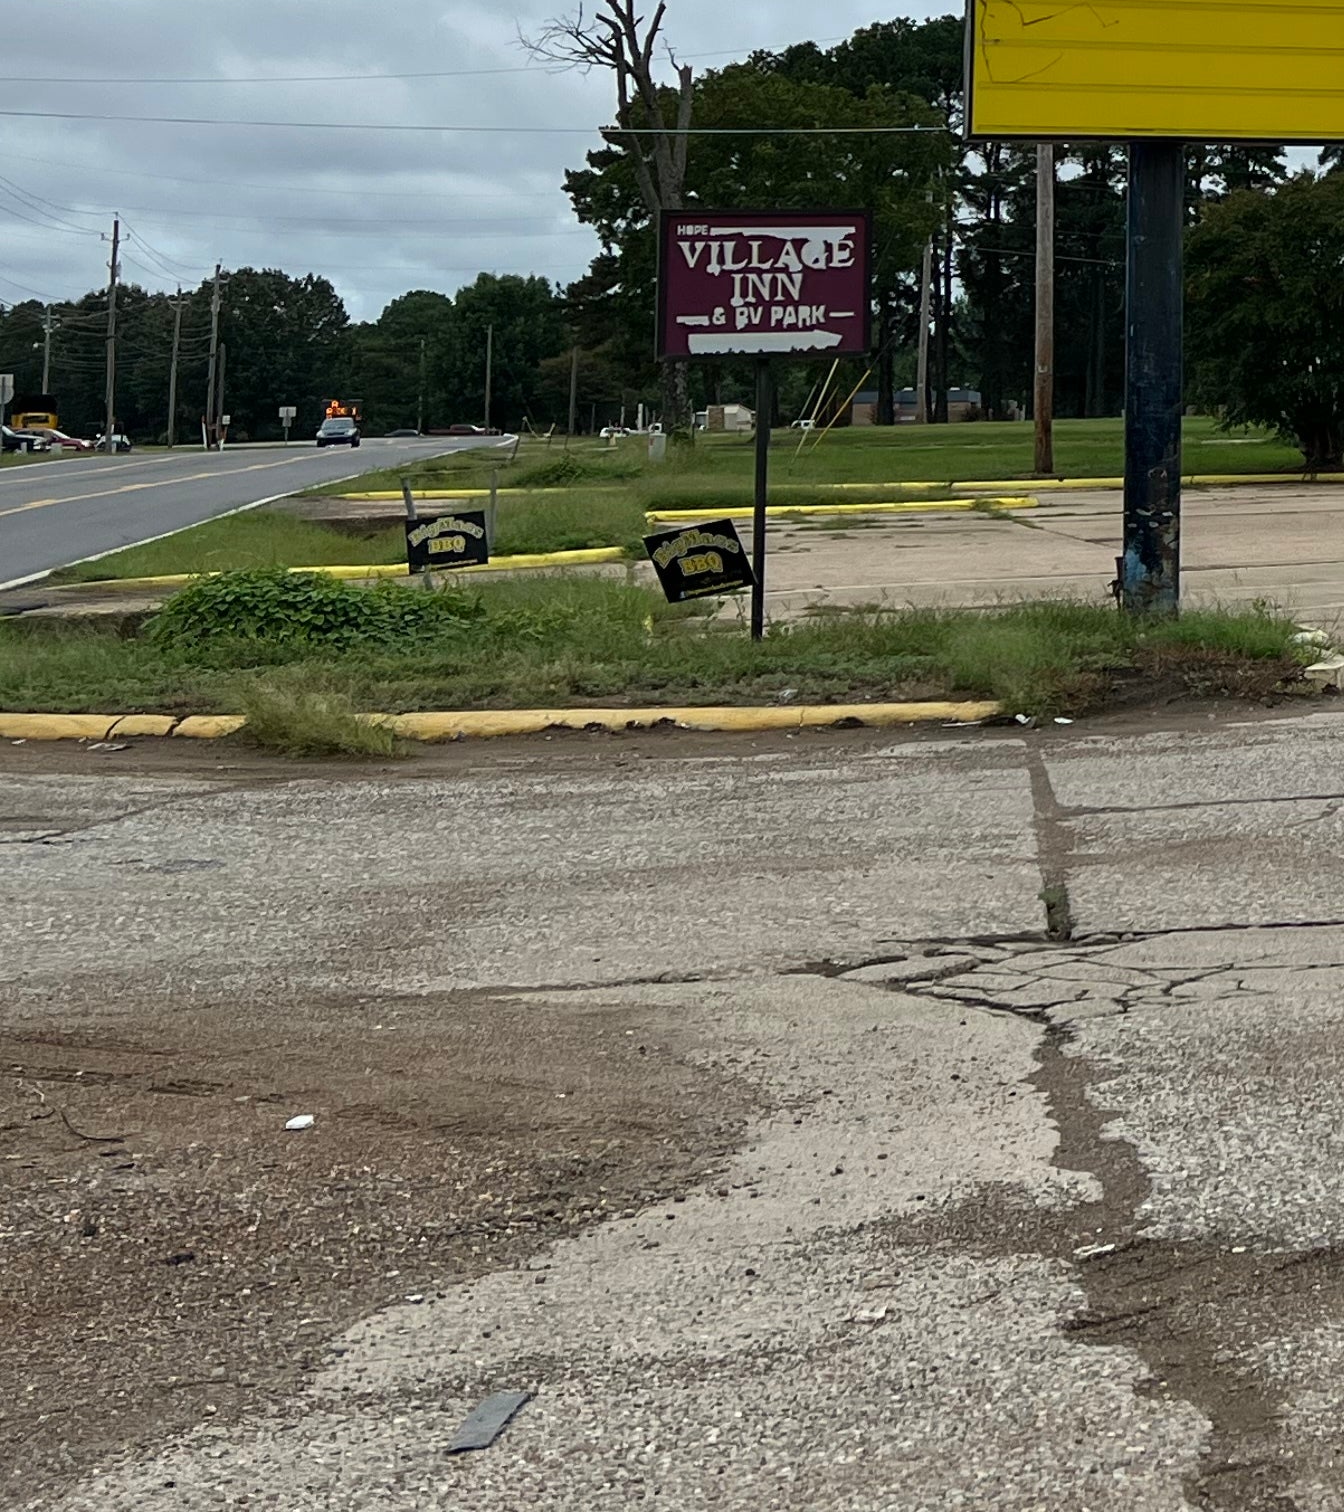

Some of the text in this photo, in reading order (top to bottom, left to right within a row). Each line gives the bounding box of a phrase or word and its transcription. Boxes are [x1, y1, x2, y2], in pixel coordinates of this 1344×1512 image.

[677, 224, 709, 236] HOPE
[677, 240, 856, 273] VILLAGE
[730, 273, 804, 305] INN
[712, 307, 727, 325] &
[770, 304, 827, 328] PARK
[428, 534, 466, 555] BBQ
[677, 551, 723, 577] BBQ
